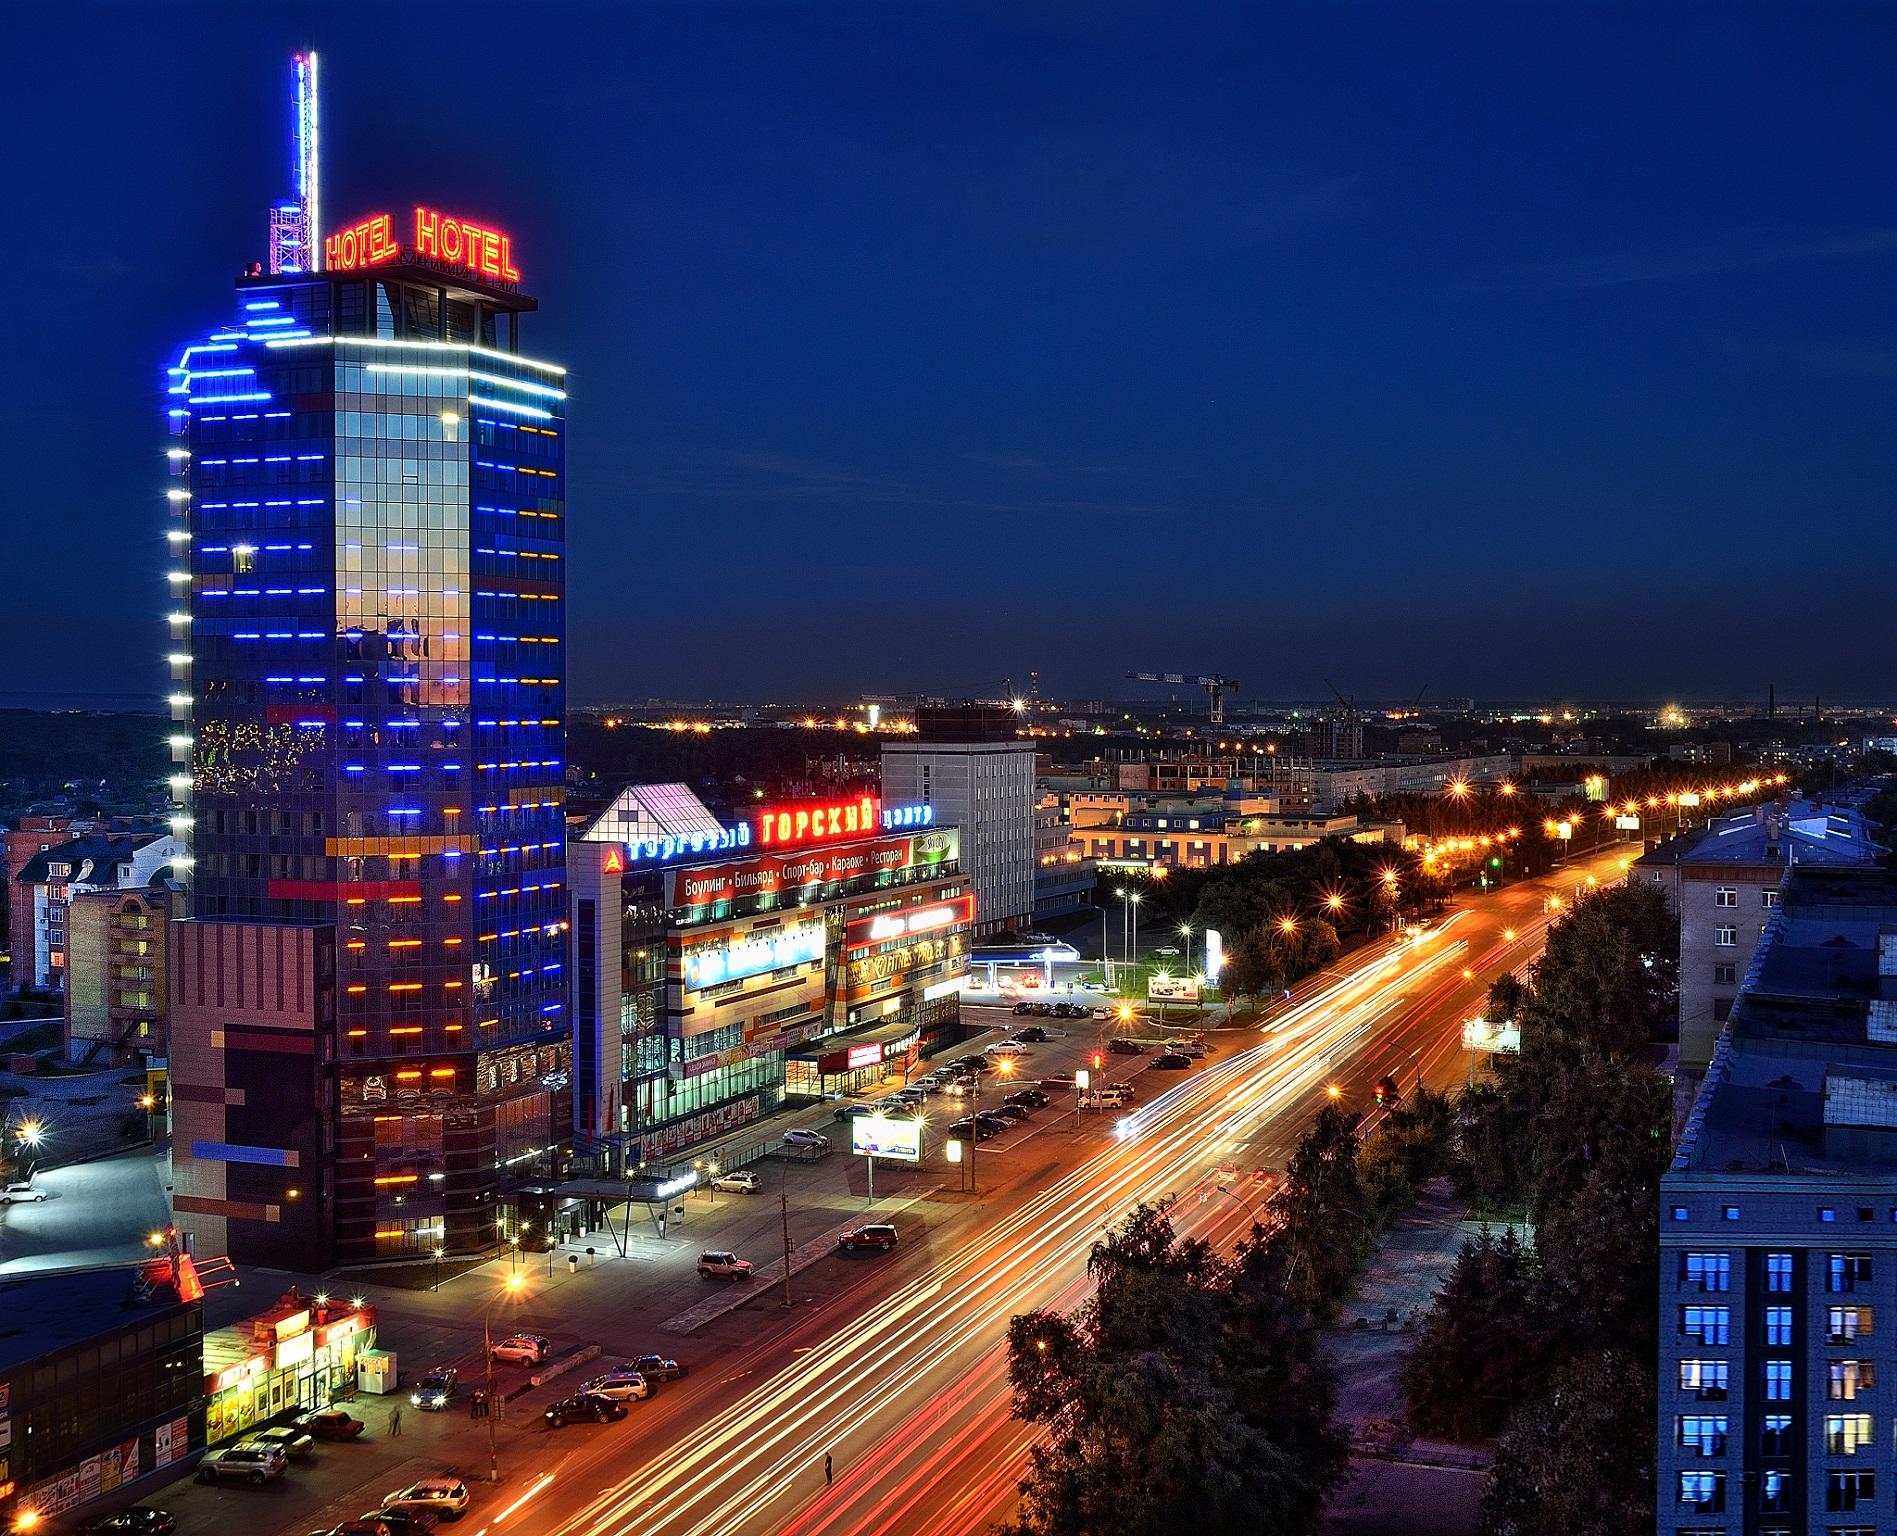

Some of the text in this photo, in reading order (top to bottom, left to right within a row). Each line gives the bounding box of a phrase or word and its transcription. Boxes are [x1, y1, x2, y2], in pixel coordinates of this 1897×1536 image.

[326, 214, 397, 271] HOTEL
[416, 207, 521, 282] HOTEL
[762, 797, 874, 843] ГОРСКИЙ
[685, 848, 903, 899] Боулинг Бильярд Спорт-бар Караоке Ресторан
